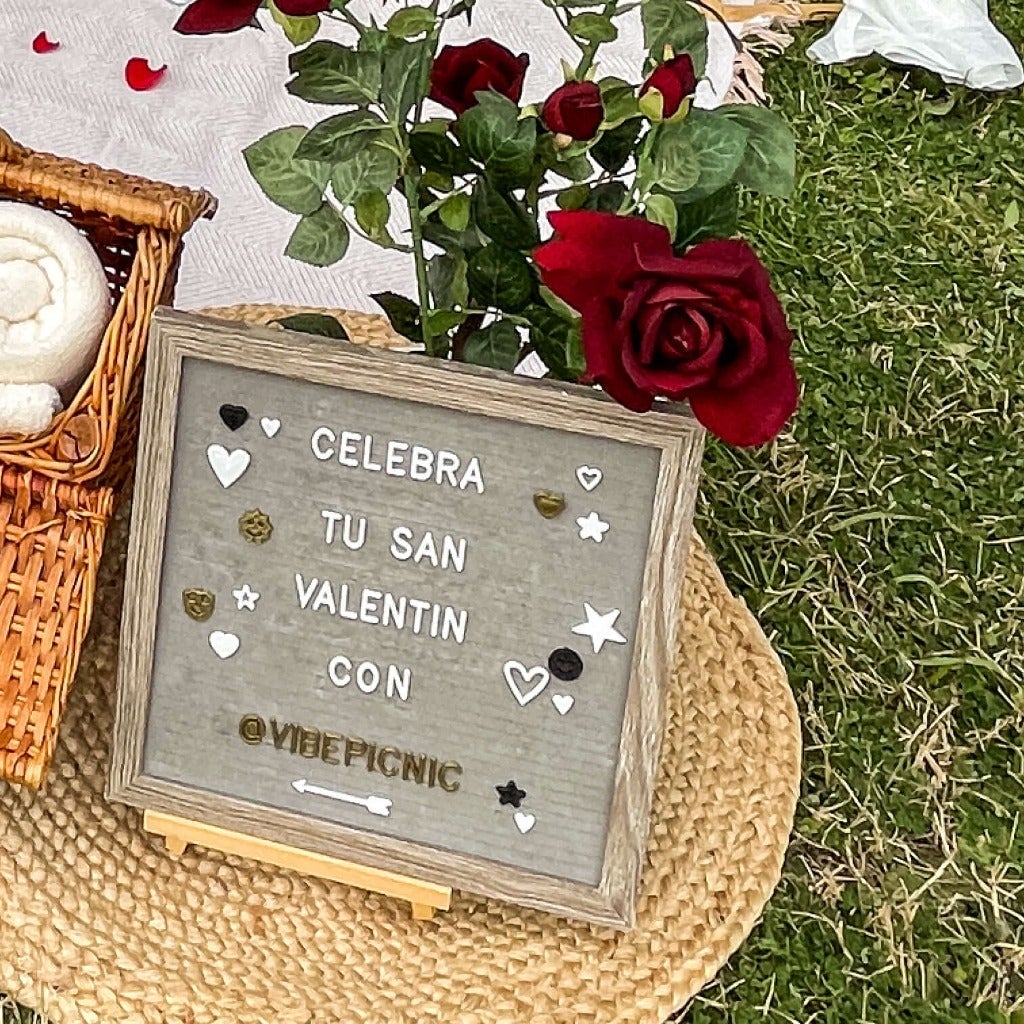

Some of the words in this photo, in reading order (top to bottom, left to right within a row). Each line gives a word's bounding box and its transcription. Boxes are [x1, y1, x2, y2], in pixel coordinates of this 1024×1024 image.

[311, 427, 485, 493] CELEBRA
[321, 510, 367, 550] TU
[391, 526, 467, 572] SAN
[295, 574, 468, 643] VALENTIN
[328, 655, 412, 700] CON
[238, 713, 463, 792] @VIBEPICNIC
